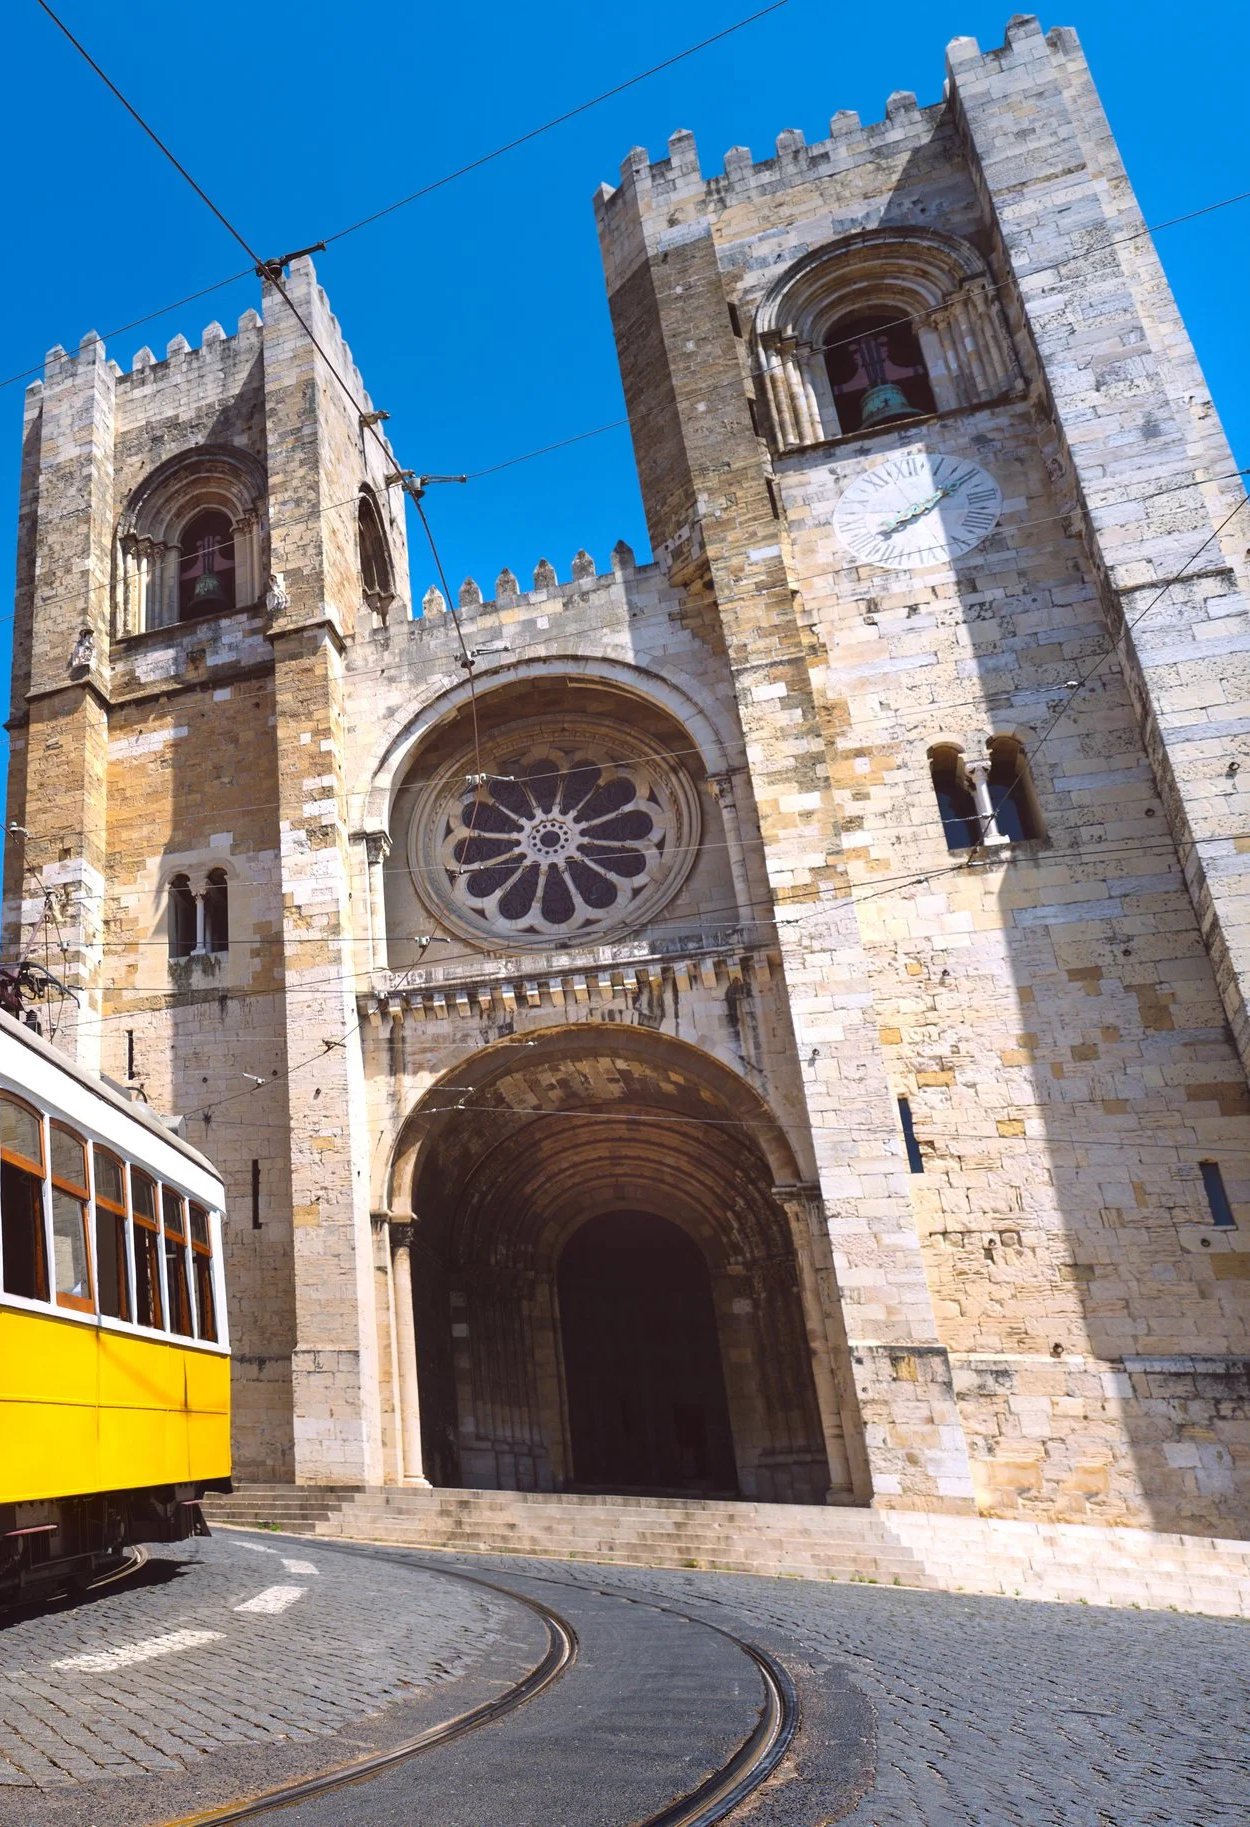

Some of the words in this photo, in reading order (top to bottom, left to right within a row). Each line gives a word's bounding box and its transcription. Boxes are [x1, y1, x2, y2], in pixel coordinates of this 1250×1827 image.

[893, 457, 919, 481] XII
[932, 457, 945, 476] I
[861, 471, 890, 492] XI
[966, 487, 998, 505] III
[961, 510, 996, 530] IIII
